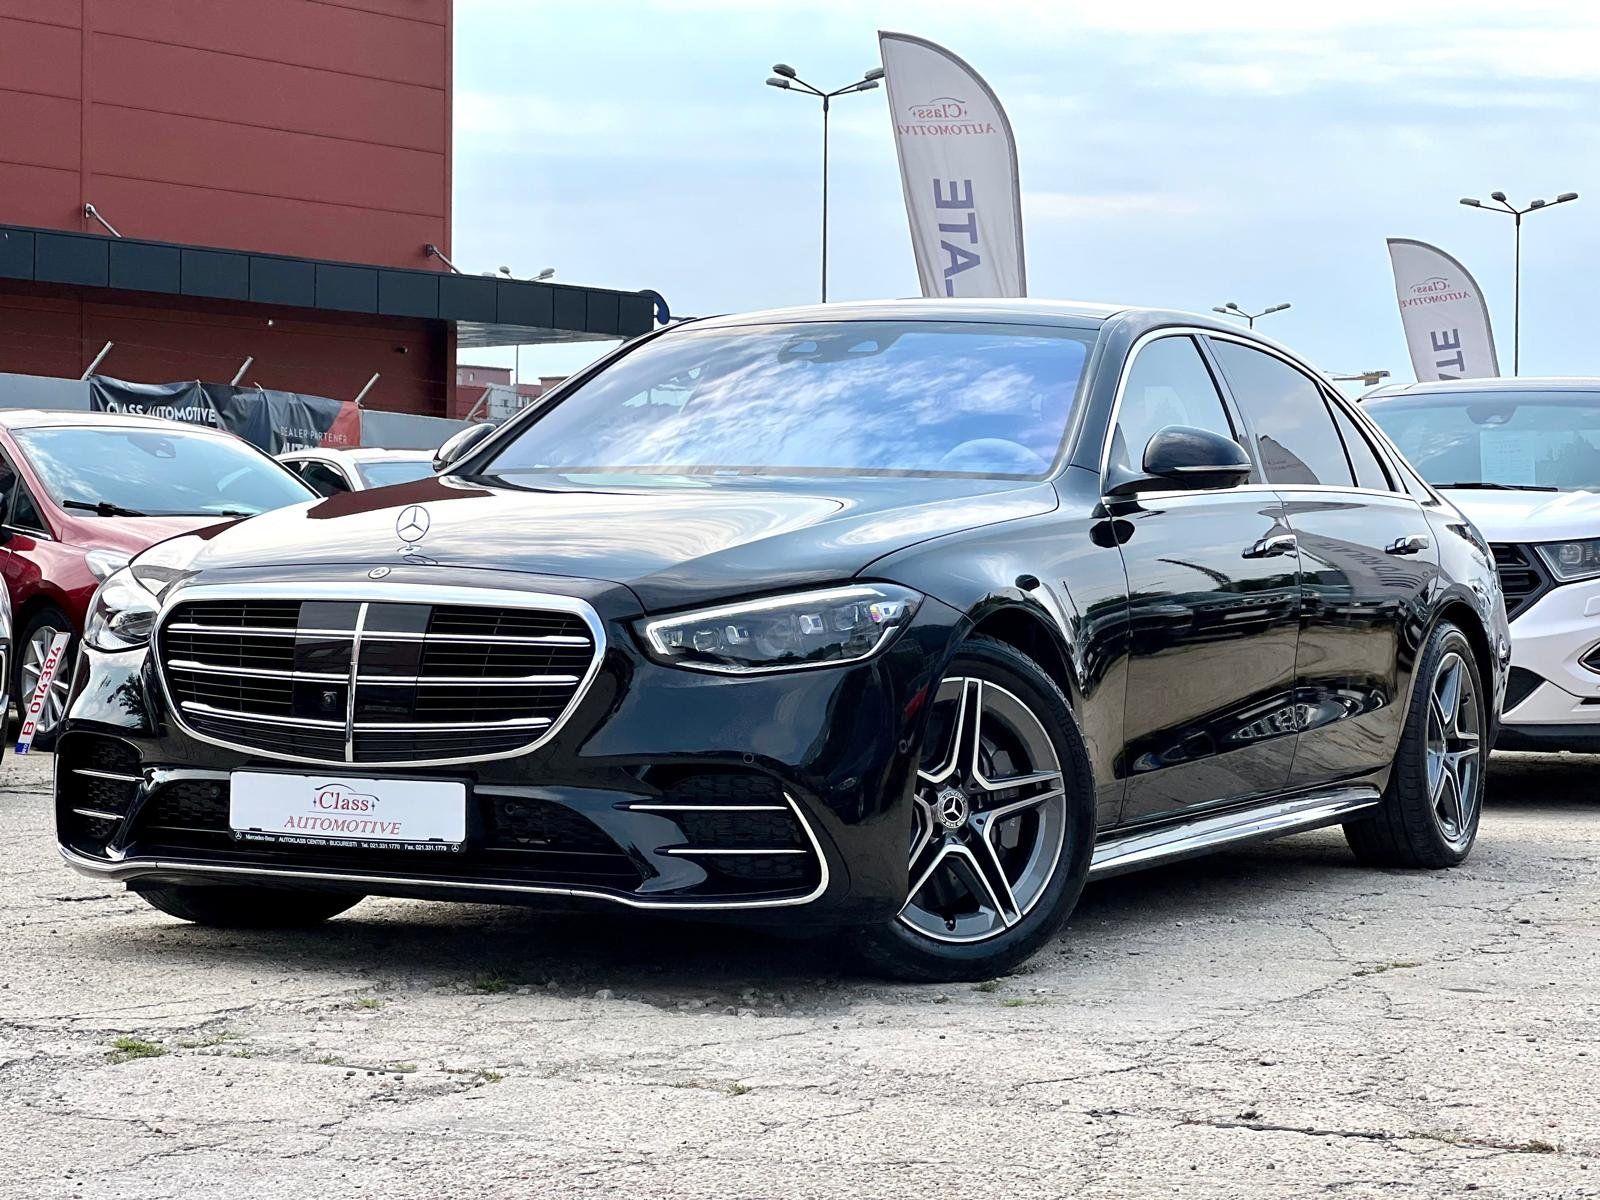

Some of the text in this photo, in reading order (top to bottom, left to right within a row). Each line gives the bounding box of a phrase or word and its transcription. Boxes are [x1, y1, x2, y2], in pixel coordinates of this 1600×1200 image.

[280, 425, 348, 443] DEALER PARTENER
[22, 646, 62, 736] B 014384
[318, 791, 370, 812] Class
[284, 815, 402, 835] AUTOMOTIVE
[279, 836, 307, 845] AUTOKLASS
